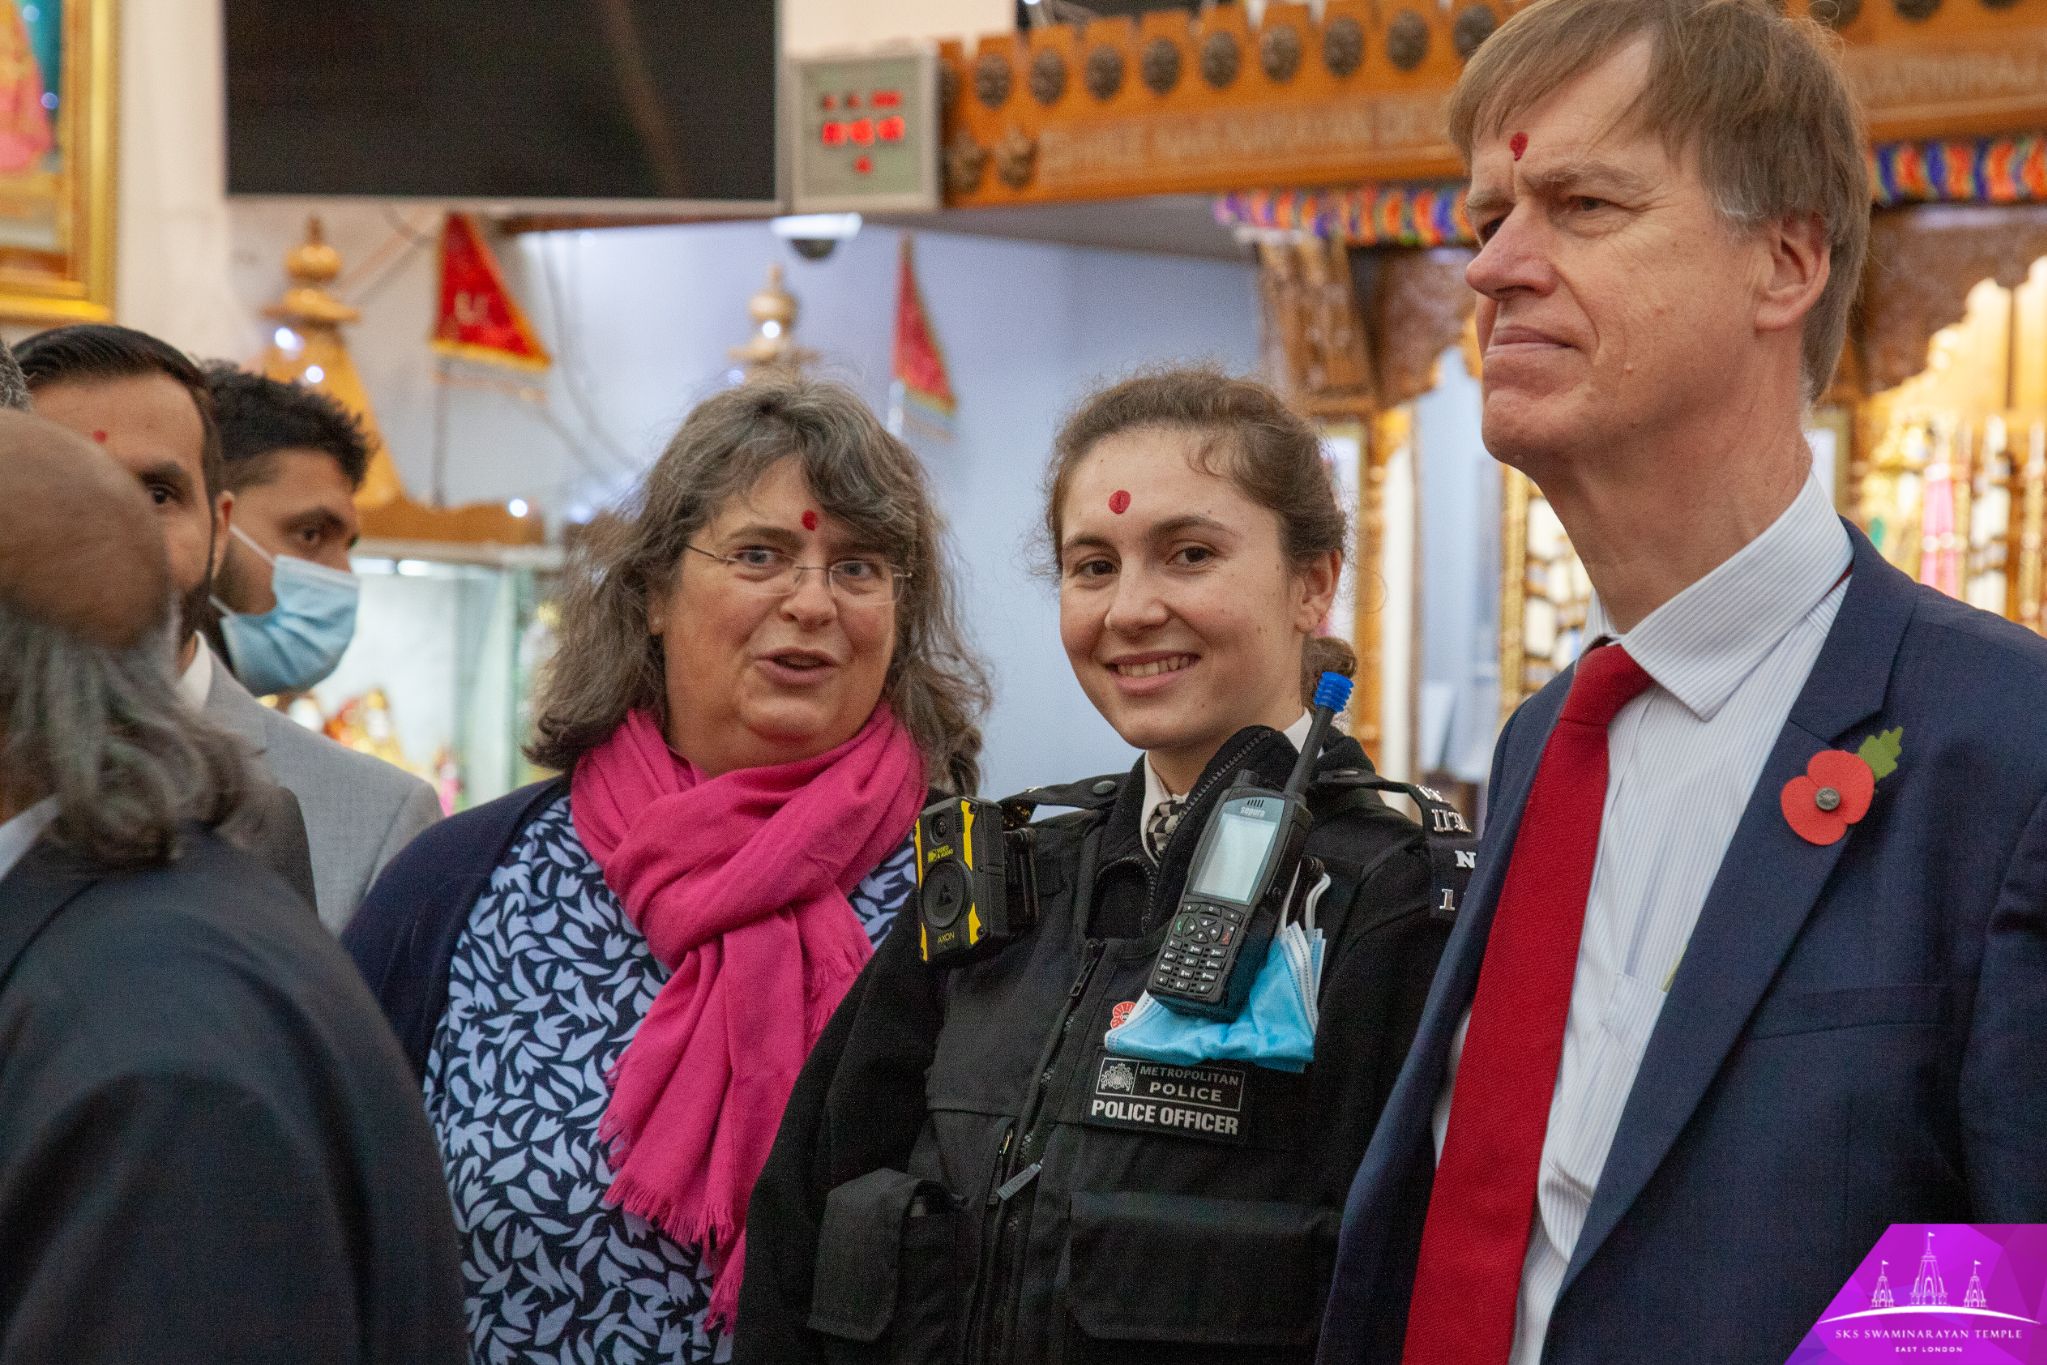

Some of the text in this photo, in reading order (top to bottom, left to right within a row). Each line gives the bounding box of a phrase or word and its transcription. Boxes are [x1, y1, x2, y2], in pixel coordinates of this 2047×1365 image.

[937, 931, 955, 945] AXON
[1139, 1065, 1240, 1086] METROPOLITAN
[1149, 1081, 1223, 1103] POLICE
[1091, 1099, 1239, 1136] POLICE OFFICER
